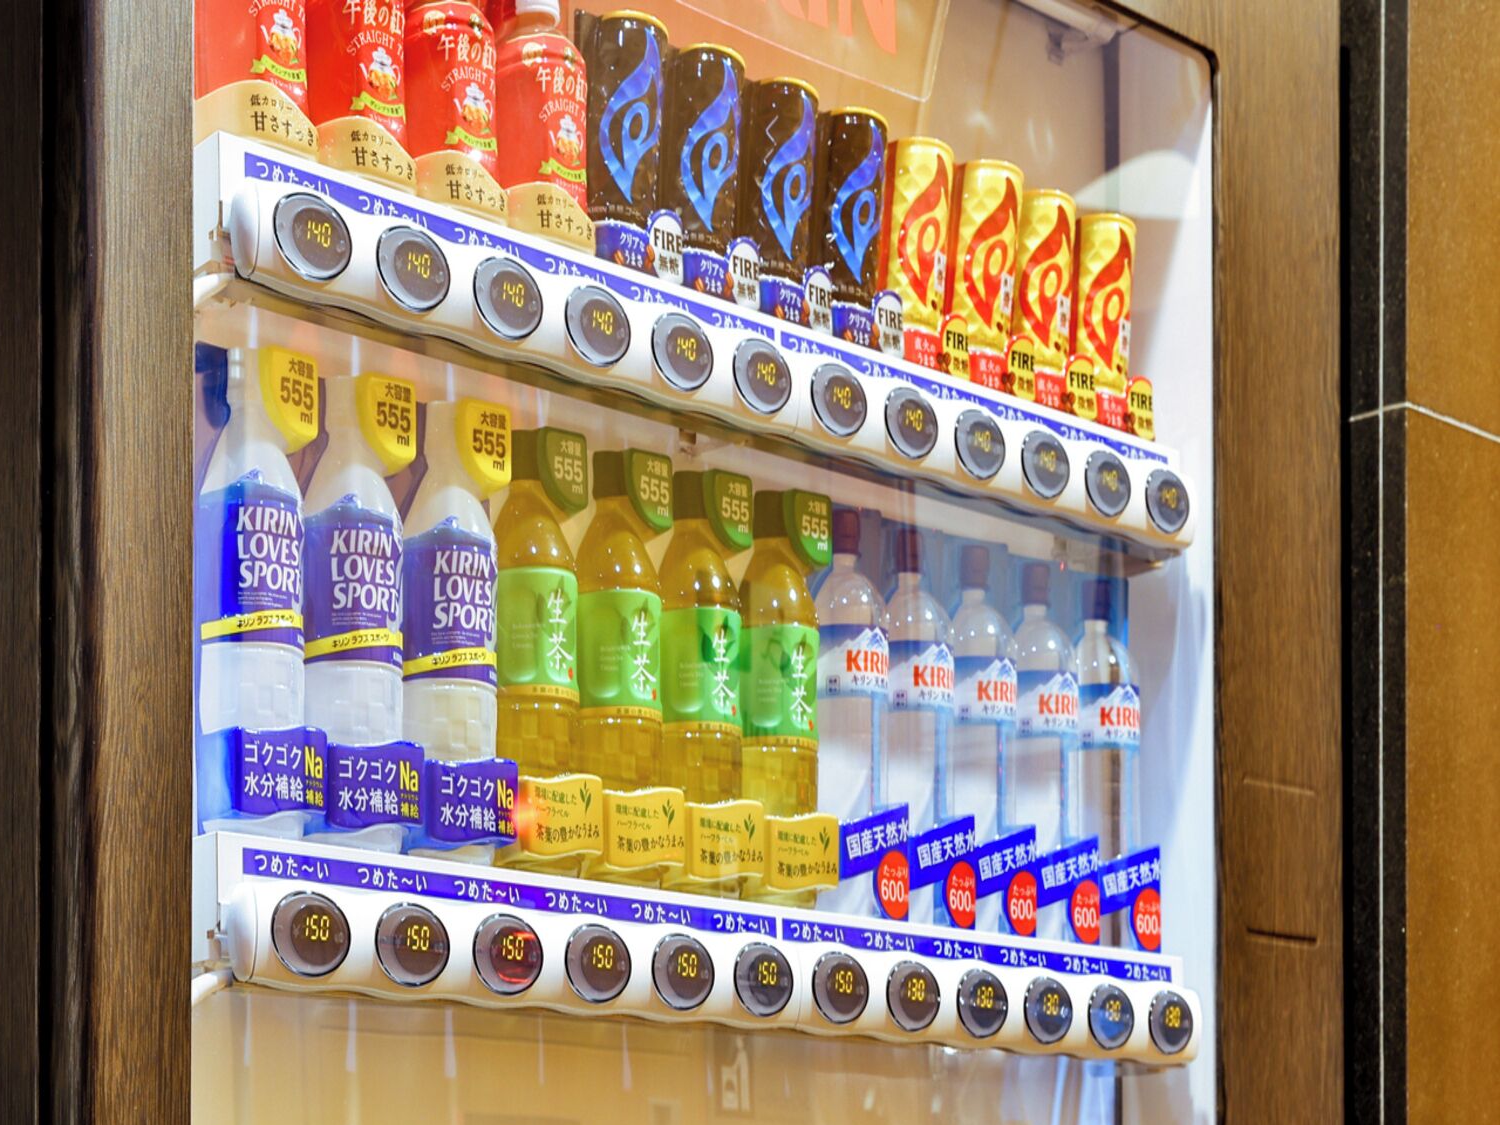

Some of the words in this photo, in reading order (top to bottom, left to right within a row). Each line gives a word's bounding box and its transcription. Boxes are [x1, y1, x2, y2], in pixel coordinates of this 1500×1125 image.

[347, 30, 395, 56] STRAIGHT
[437, 33, 496, 70] 午後の紅
[441, 67, 488, 92] STRAIGHT
[536, 67, 587, 102] 午後の紅
[539, 100, 580, 123] STRAIGHT
[307, 220, 333, 249] 140
[653, 227, 682, 253] FIRE
[407, 253, 432, 279] 140
[732, 255, 759, 281] FIRE
[501, 282, 525, 308] 140
[593, 310, 614, 335] 140
[676, 336, 698, 361] 140
[289, 358, 314, 380] 大容量
[756, 362, 777, 385] 140
[280, 377, 314, 411] 555
[384, 382, 411, 404] 大容量
[301, 411, 313, 425] ml
[376, 402, 411, 433] 555
[480, 411, 506, 430] 大容量
[396, 434, 410, 447] ml
[472, 429, 506, 458] 555
[492, 458, 505, 471] ml
[554, 456, 583, 482] 555
[640, 478, 670, 505] 555
[236, 507, 297, 538] KIRIN
[721, 497, 749, 522] 555
[802, 515, 828, 540] 555
[237, 533, 300, 562] LOVES
[330, 529, 393, 558] KIRIN
[331, 556, 395, 584] LOVES
[433, 550, 490, 577] KIRIN
[239, 560, 300, 596] SPORT
[434, 575, 491, 604] LOVES
[332, 582, 399, 616] SPORT
[433, 603, 495, 633] SPORT
[547, 588, 573, 672] 生茶
[631, 610, 656, 692] 生茶
[712, 629, 736, 707] 生茶
[790, 645, 812, 722] 生茶
[244, 740, 302, 769] ゴクゴク
[304, 746, 323, 779] Na
[339, 757, 397, 784] ゴクゴク
[400, 761, 419, 791] Na
[244, 772, 304, 803] 水分補給
[306, 788, 323, 808] 補給
[441, 773, 495, 801] ゴクゴク
[497, 779, 514, 809] Na
[339, 788, 398, 816] 水分補給
[400, 802, 419, 819] 補給
[440, 803, 496, 832] 水分補給
[498, 819, 514, 835] 補給
[536, 824, 599, 844] 茶葉の豊かなうまみ
[617, 836, 684, 852] 茶葉の豊かなうまみ
[846, 818, 910, 860] 国産天然水
[881, 879, 905, 903] 600
[950, 888, 972, 912] 600
[1010, 896, 1034, 920] 600
[1074, 904, 1096, 928] 600
[304, 913, 332, 942] 150
[1136, 911, 1157, 934] 600
[406, 923, 431, 952] 150
[501, 933, 524, 960] 150
[592, 944, 615, 970] 150
[677, 951, 699, 978] 150
[758, 962, 778, 985] 150
[835, 969, 853, 994] 150
